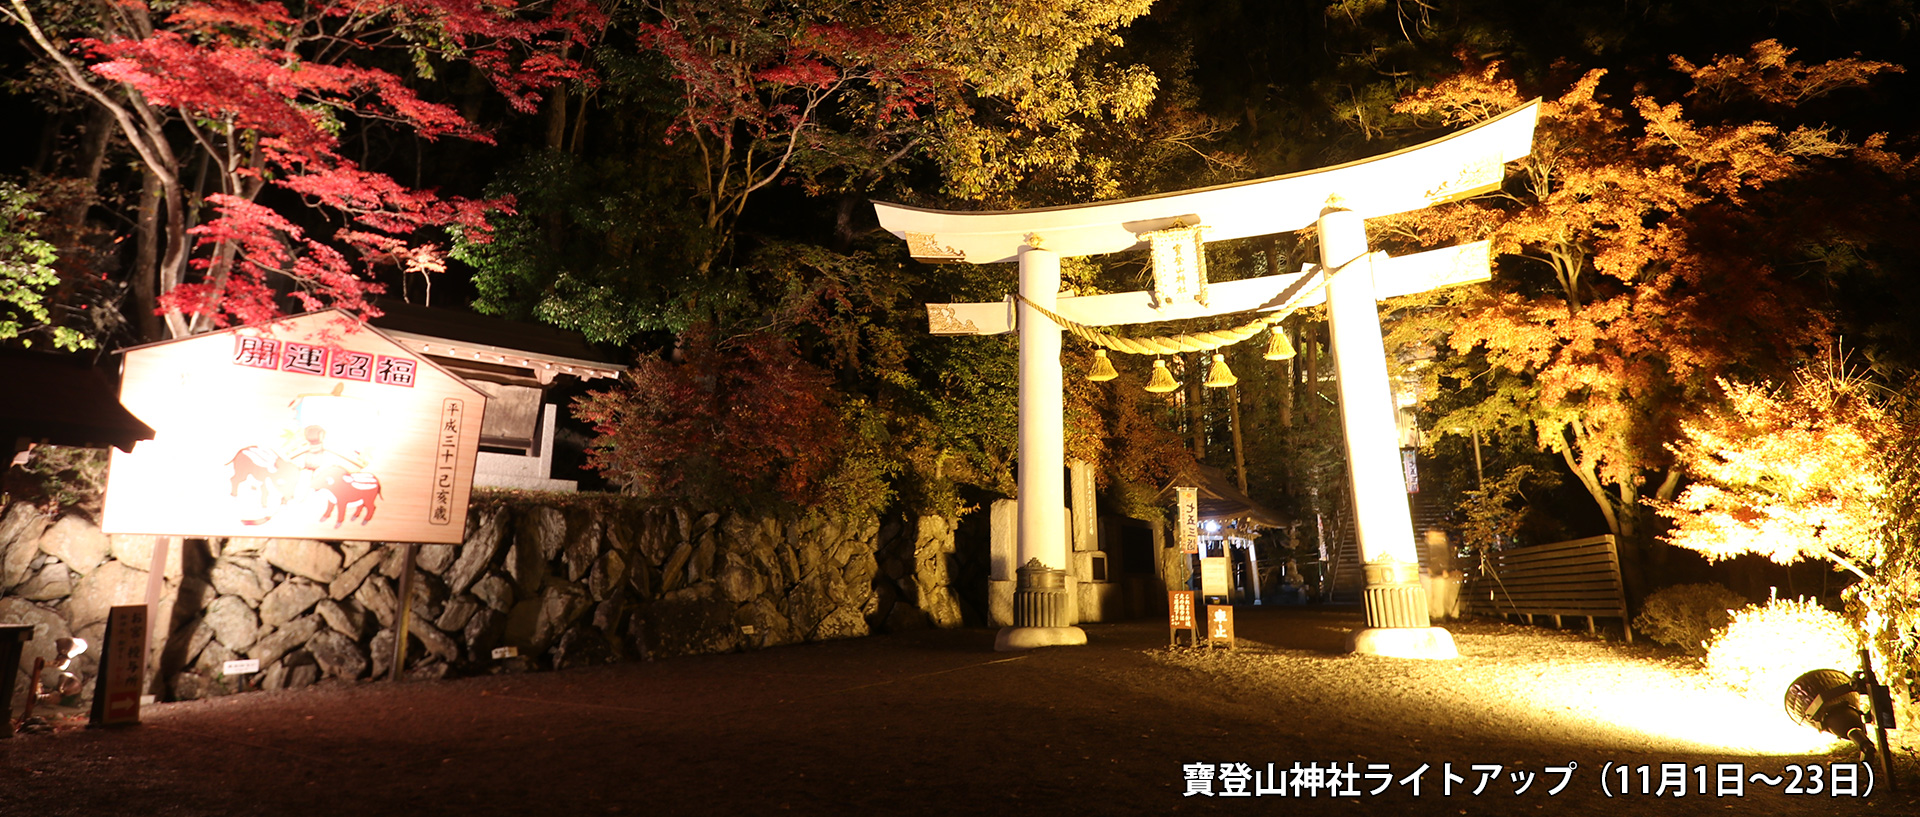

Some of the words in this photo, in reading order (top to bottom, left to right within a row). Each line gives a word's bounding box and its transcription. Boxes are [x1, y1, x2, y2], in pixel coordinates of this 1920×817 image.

[235, 337, 414, 385] 開運招福
[432, 402, 460, 521] 平成三十一己亥歳
[1213, 608, 1228, 638] 車止
